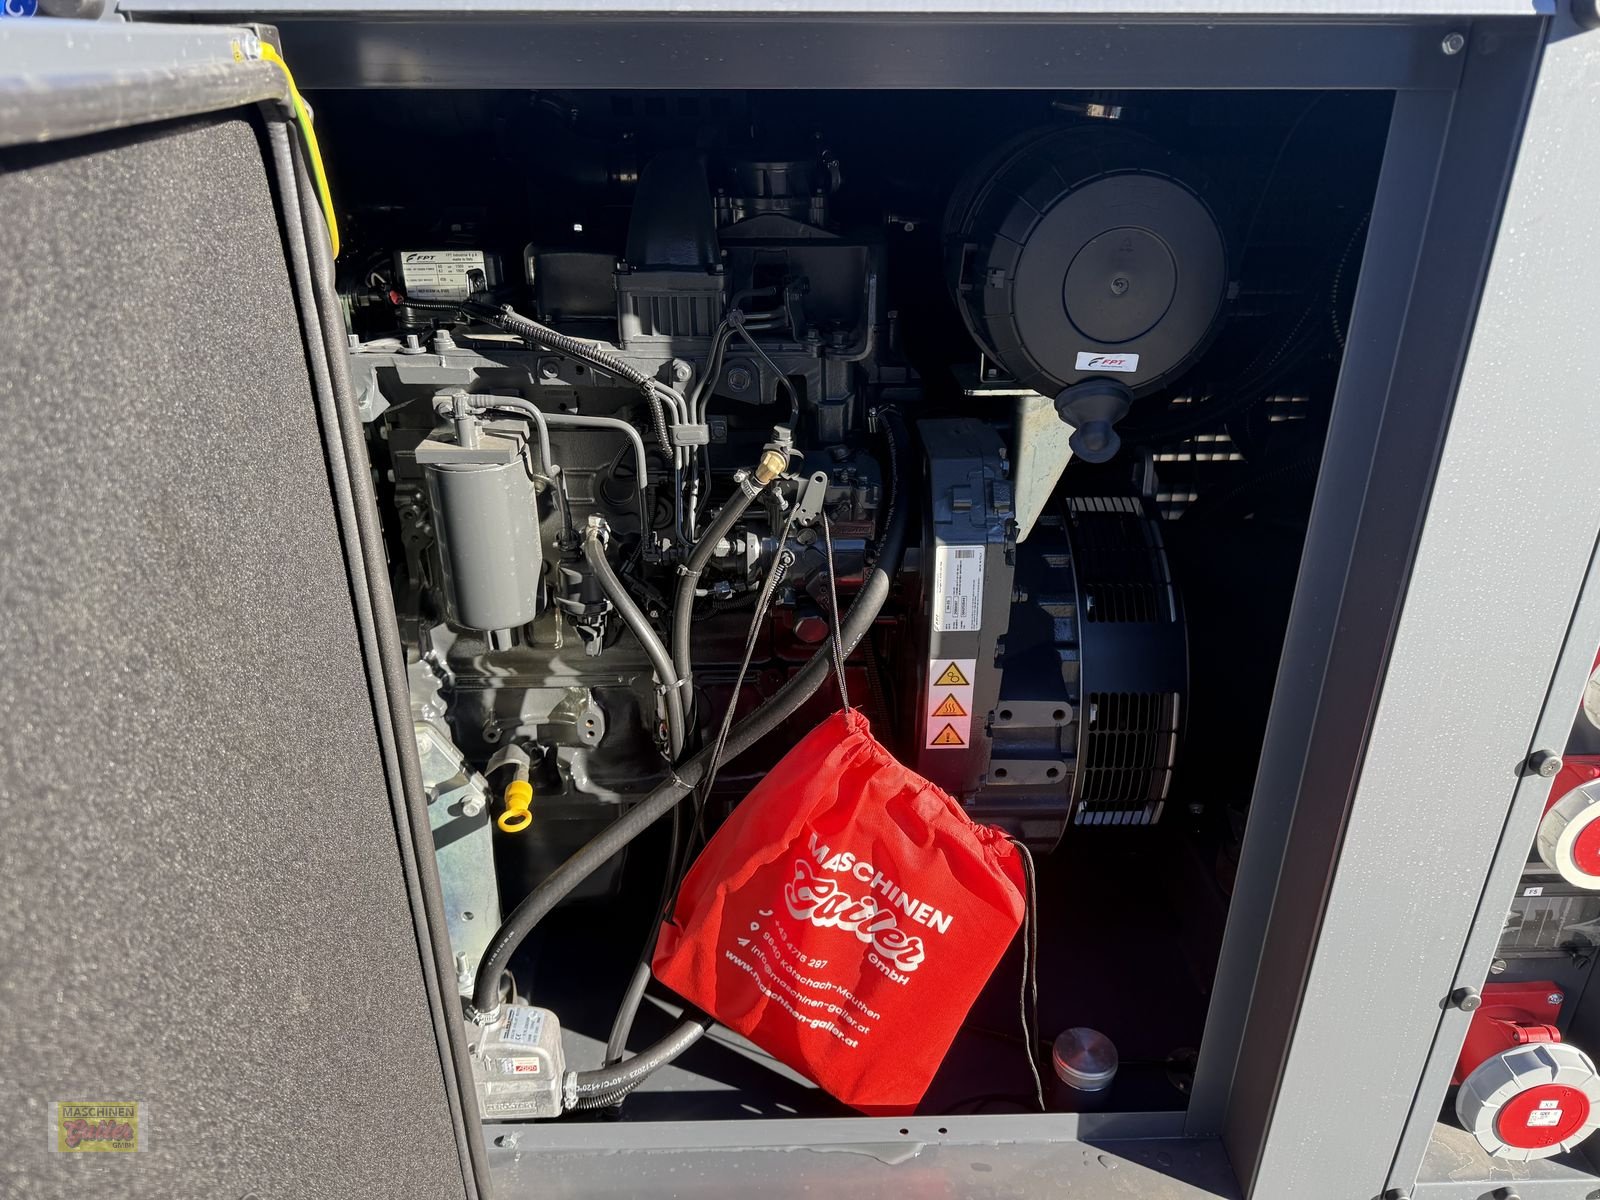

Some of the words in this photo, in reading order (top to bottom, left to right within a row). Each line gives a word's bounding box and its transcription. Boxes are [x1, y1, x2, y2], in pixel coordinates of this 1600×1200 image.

[808, 832, 953, 934] MASCHINEN
[762, 931, 781, 959] 9640
[786, 943, 808, 963] 4715
[808, 958, 828, 969] 297
[868, 953, 910, 985] GmbH
[725, 949, 859, 1048] www.maschinen-gailer.at
[751, 944, 870, 1034] info@maschinen-gailer.at
